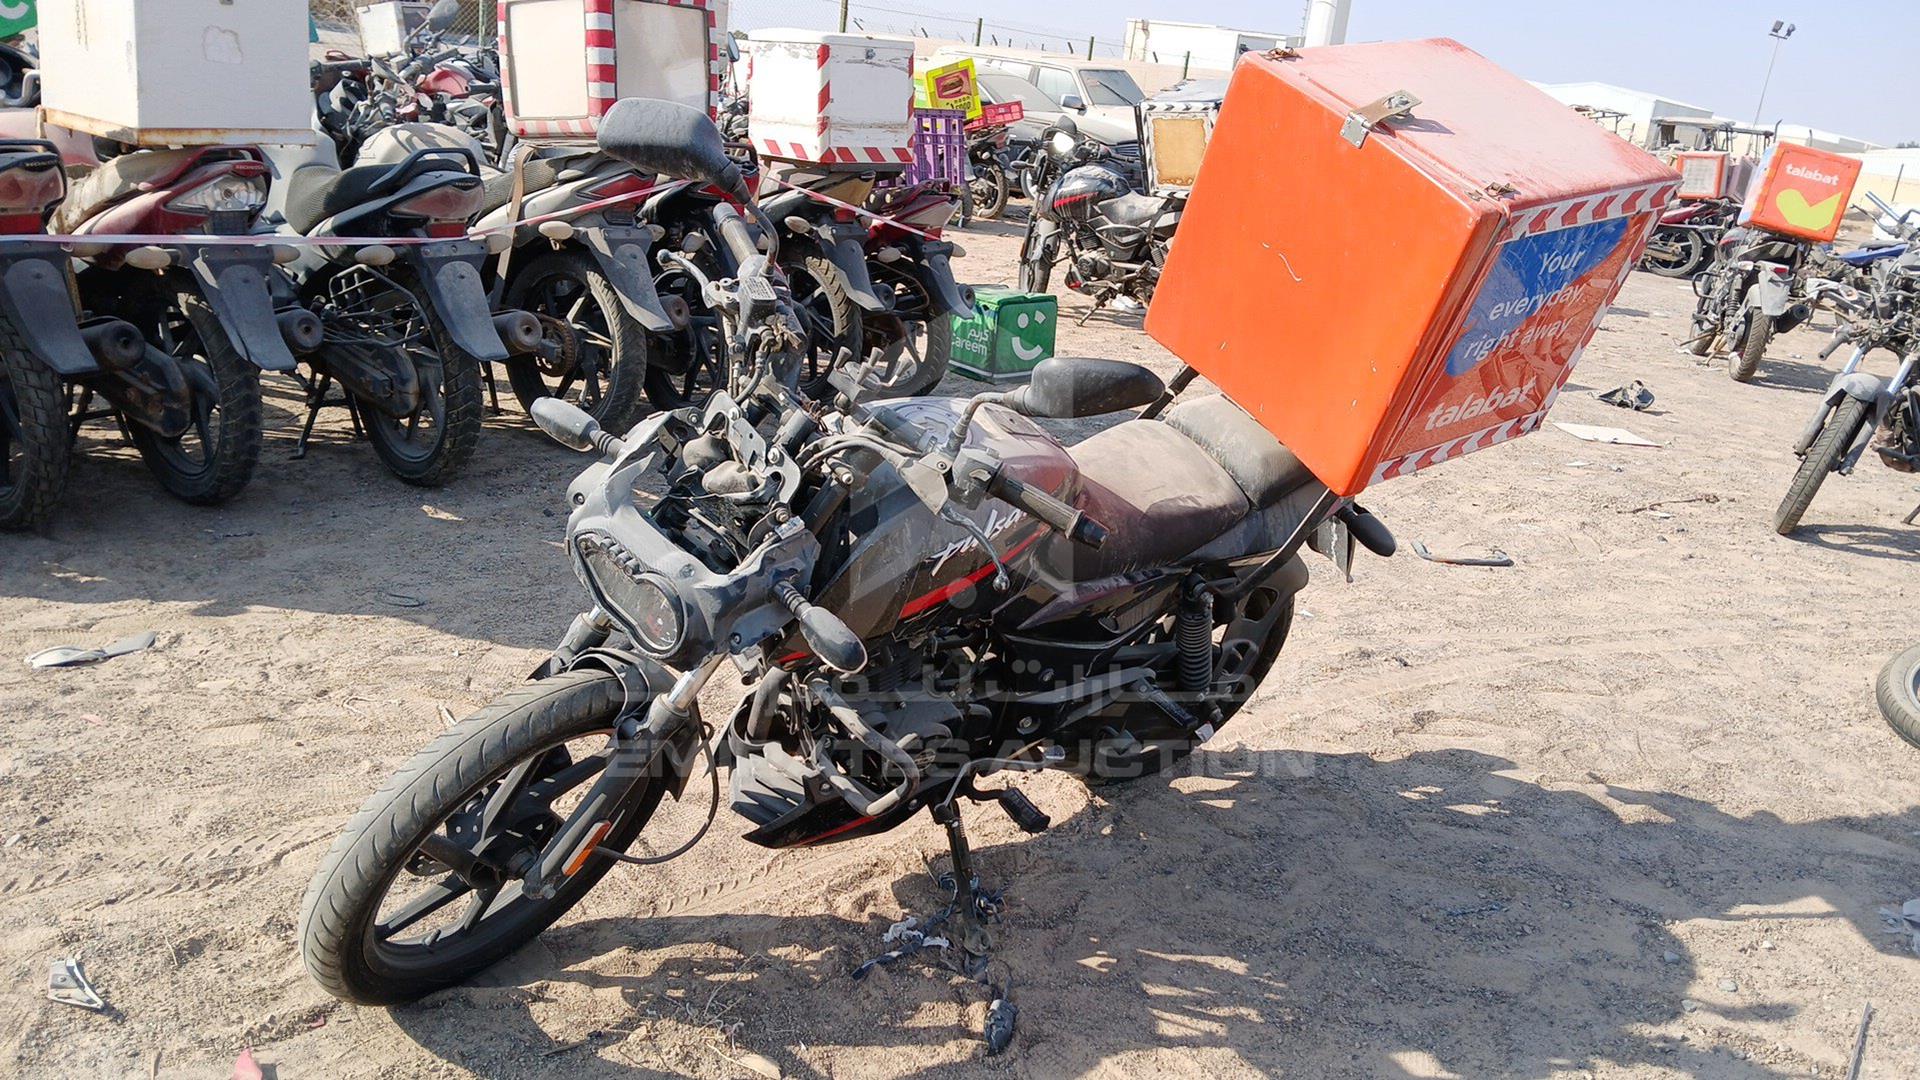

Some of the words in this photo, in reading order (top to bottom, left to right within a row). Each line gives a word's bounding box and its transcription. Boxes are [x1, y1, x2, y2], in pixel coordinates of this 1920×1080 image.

[1786, 162, 1839, 186] talabat
[1539, 249, 1587, 275] Your
[967, 327, 989, 342] كريم
[1463, 328, 1521, 361] right
[1521, 316, 1574, 346] away
[1425, 374, 1538, 431] talabat
[923, 508, 1028, 577] pulsa
